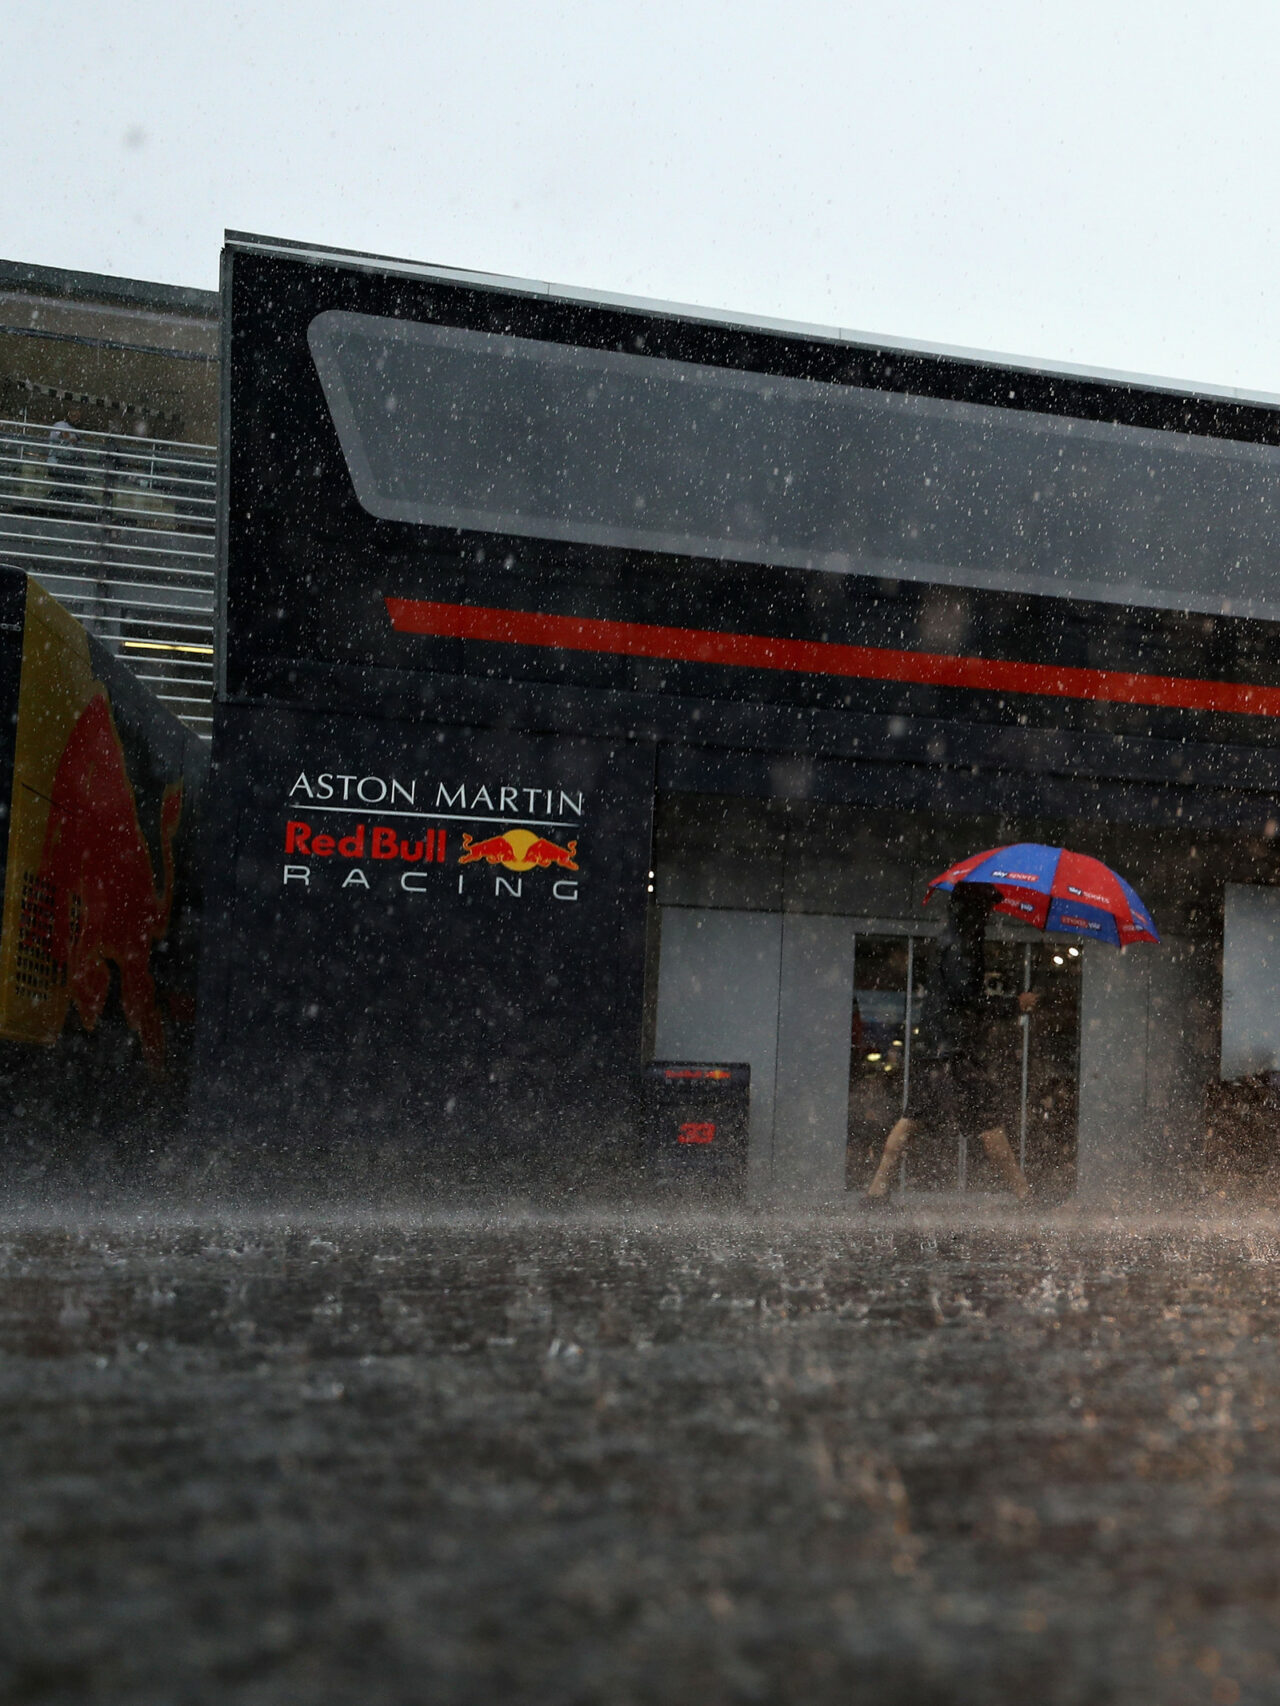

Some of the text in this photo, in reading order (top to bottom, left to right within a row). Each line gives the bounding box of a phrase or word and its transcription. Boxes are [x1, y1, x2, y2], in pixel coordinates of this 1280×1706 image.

[289, 772, 583, 817] ASTON MARTIN
[284, 821, 447, 863] Red Bull
[283, 865, 579, 901] RACING
[677, 1122, 716, 1144] 33
